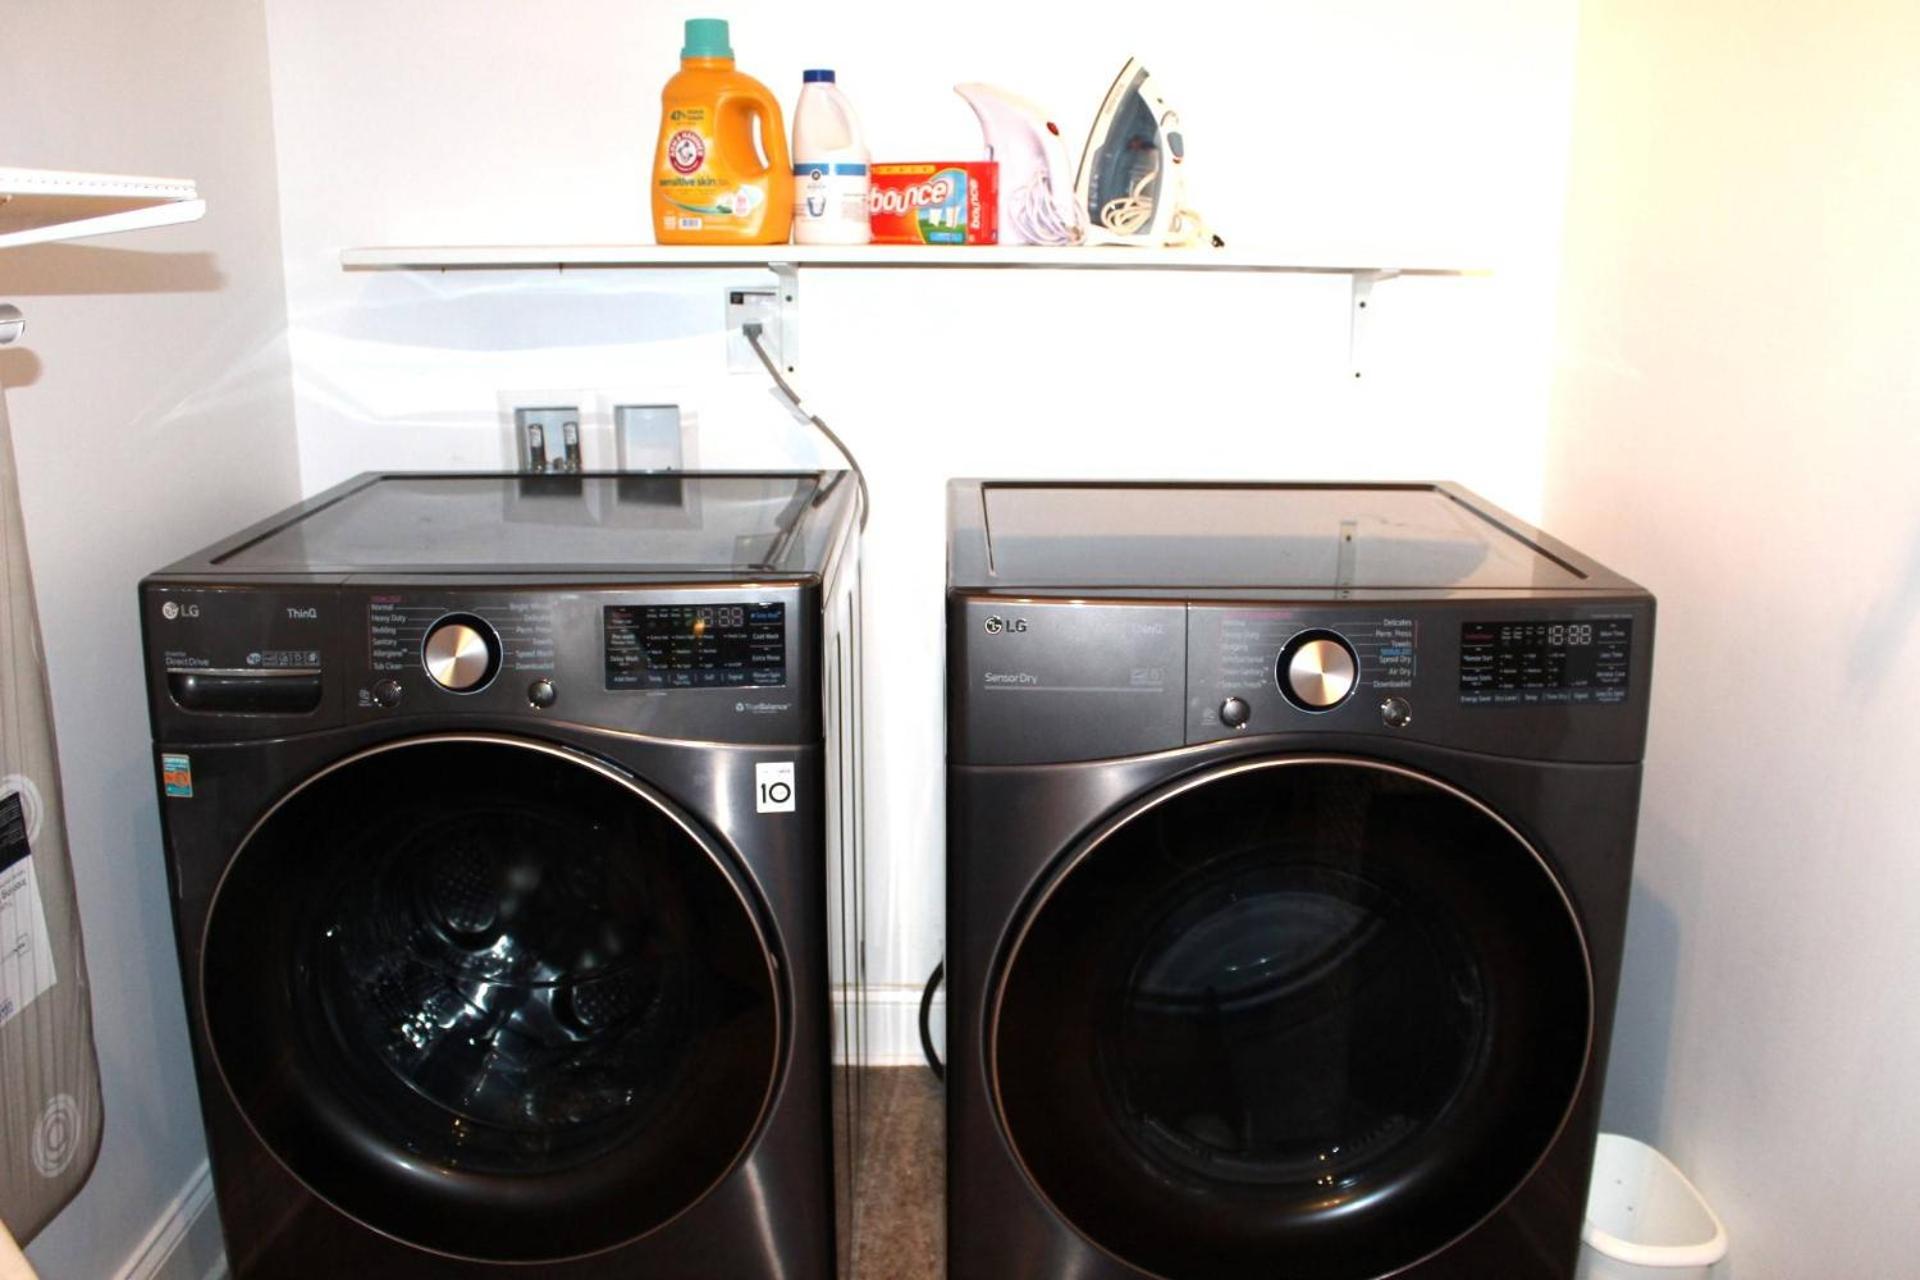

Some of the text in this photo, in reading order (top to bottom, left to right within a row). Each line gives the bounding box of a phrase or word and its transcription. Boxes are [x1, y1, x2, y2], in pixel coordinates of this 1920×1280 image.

[659, 177, 695, 187] sensitive
[697, 176, 716, 186] skin
[868, 180, 949, 214] bounce
[181, 605, 199, 617] LG
[287, 607, 317, 619] ThinQ
[1006, 619, 1027, 633] LG
[760, 781, 792, 804] 10
